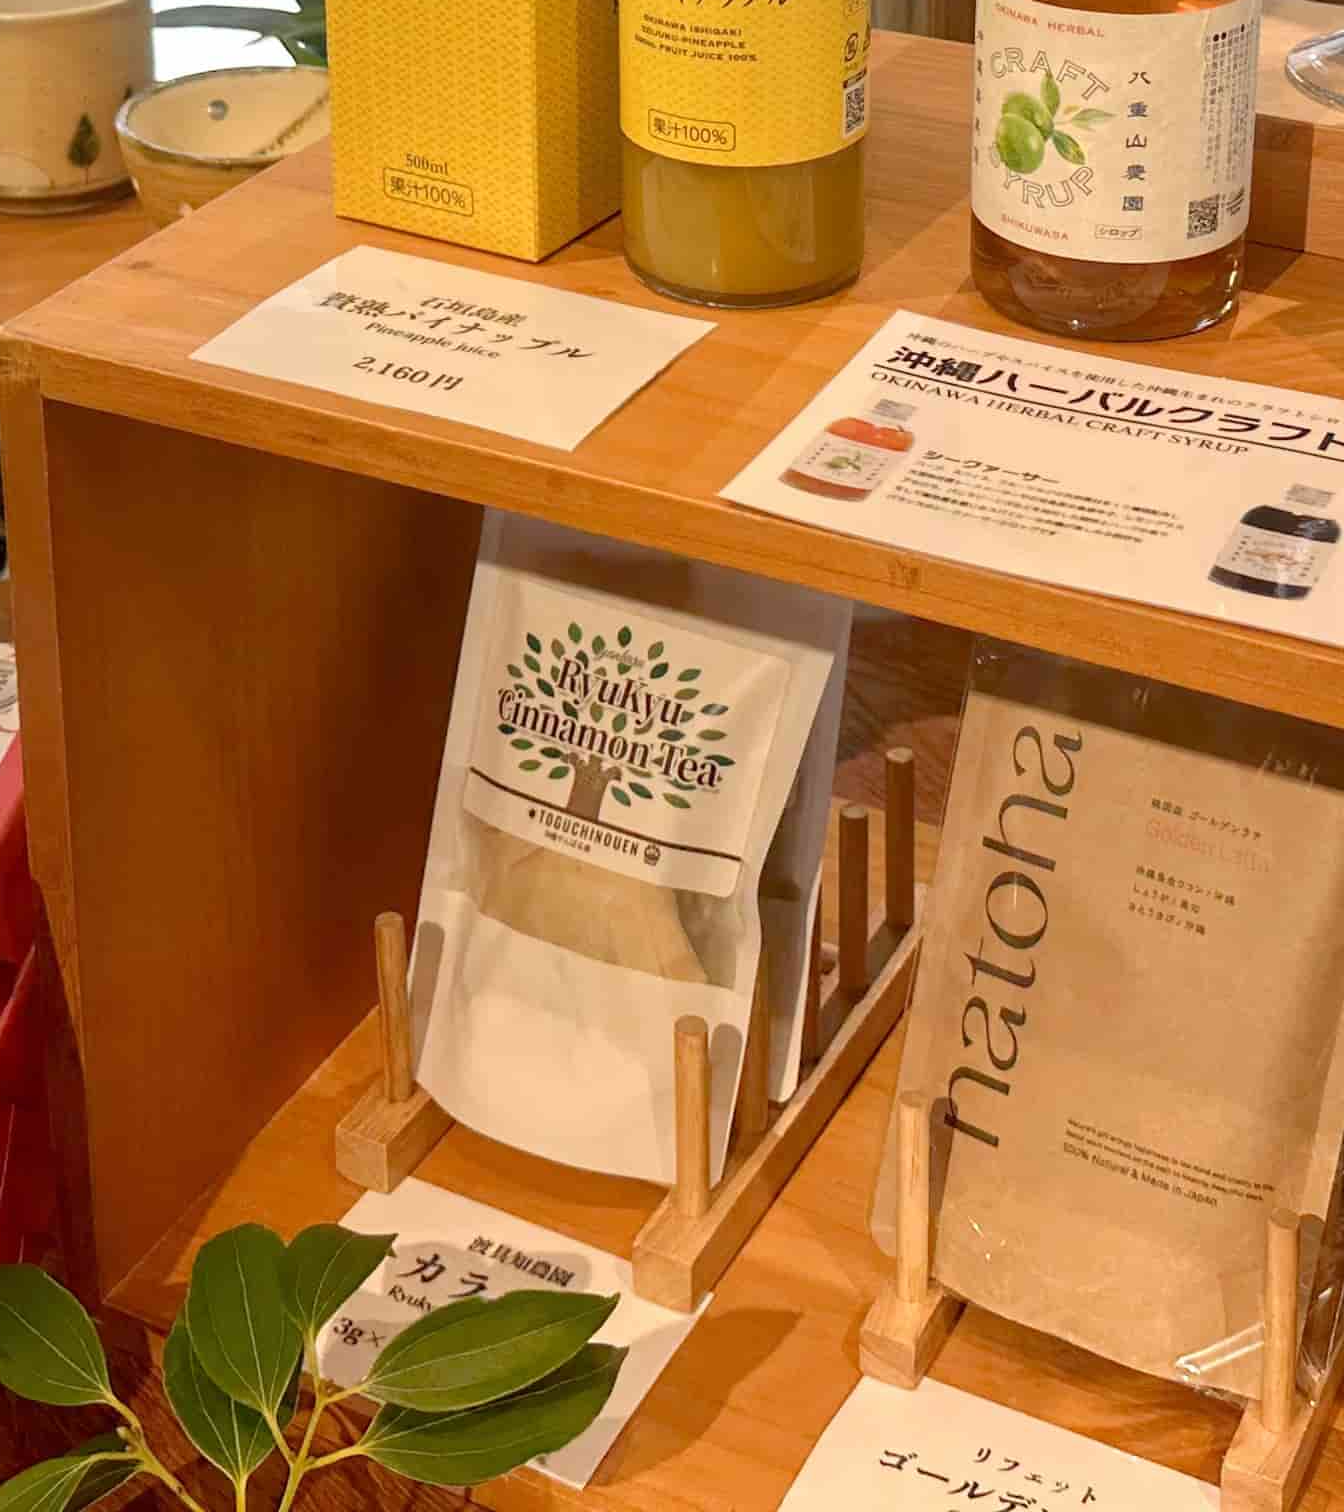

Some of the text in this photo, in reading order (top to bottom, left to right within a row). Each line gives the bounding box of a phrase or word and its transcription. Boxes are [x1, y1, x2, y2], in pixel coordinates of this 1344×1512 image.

[1047, 21, 1105, 38] HERBAL
[989, 47, 1110, 102] CRAFT
[653, 117, 728, 145] 果汁100%
[405, 151, 450, 178] 500ml
[388, 174, 467, 210] 果汁100%
[364, 321, 453, 351] Pineapple
[352, 354, 464, 393] 2,160円
[870, 370, 1250, 458] OKINAWA HERBAL CRAFT SYRUP
[497, 688, 723, 789] Cinnamon Tea
[538, 809, 639, 857] TOGUCHINOUEN
[877, 1448, 1049, 1512] ゴールデ
[973, 1446, 1098, 1505] リフェット
